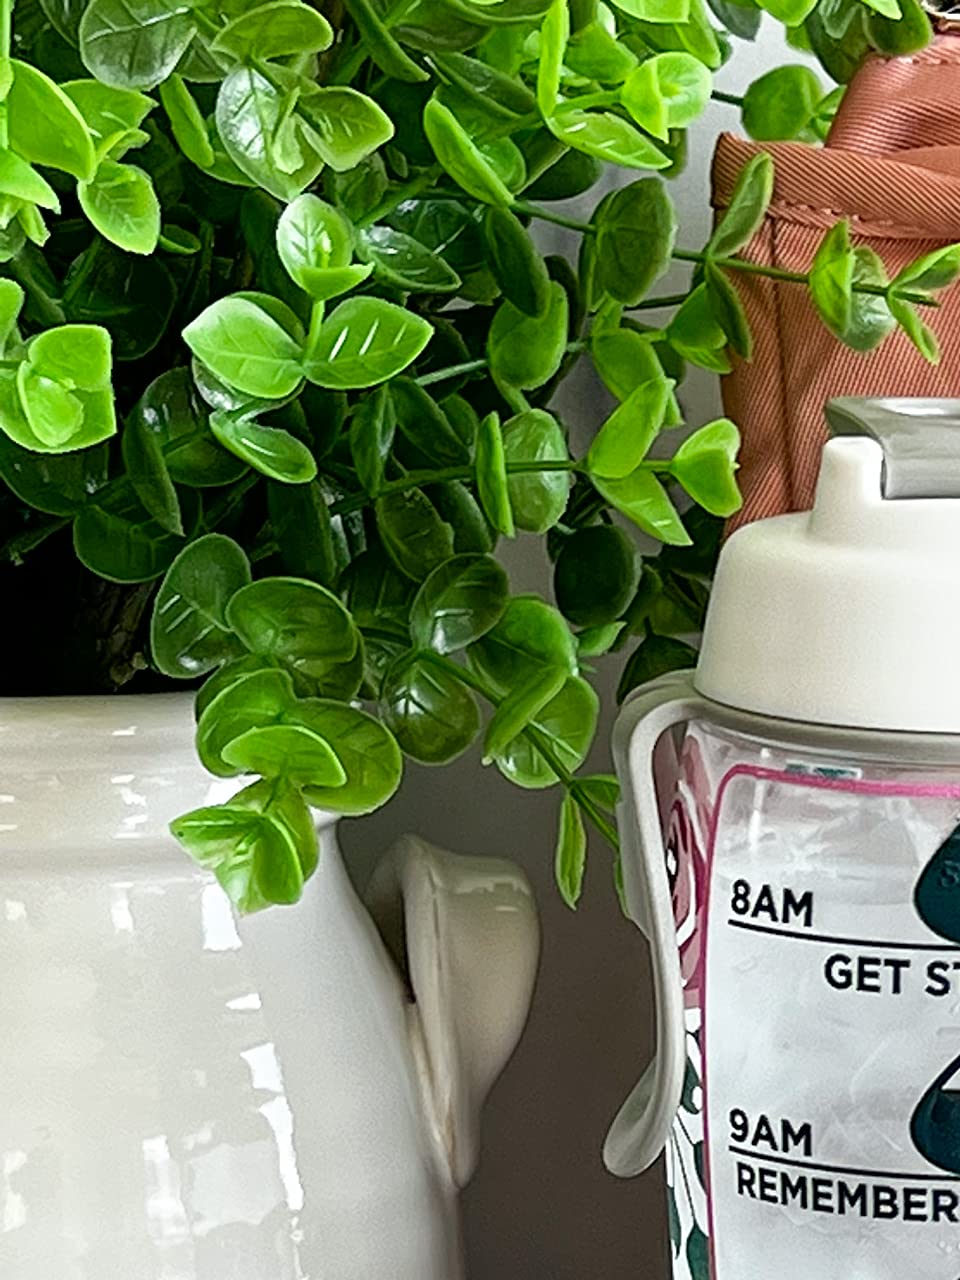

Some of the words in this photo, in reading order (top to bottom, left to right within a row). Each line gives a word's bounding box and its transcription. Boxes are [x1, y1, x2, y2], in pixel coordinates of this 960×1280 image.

[730, 880, 814, 927] 8AM
[824, 954, 910, 996] GET
[728, 1110, 812, 1156] 9AM
[737, 1165, 959, 1222] REMEMBER
